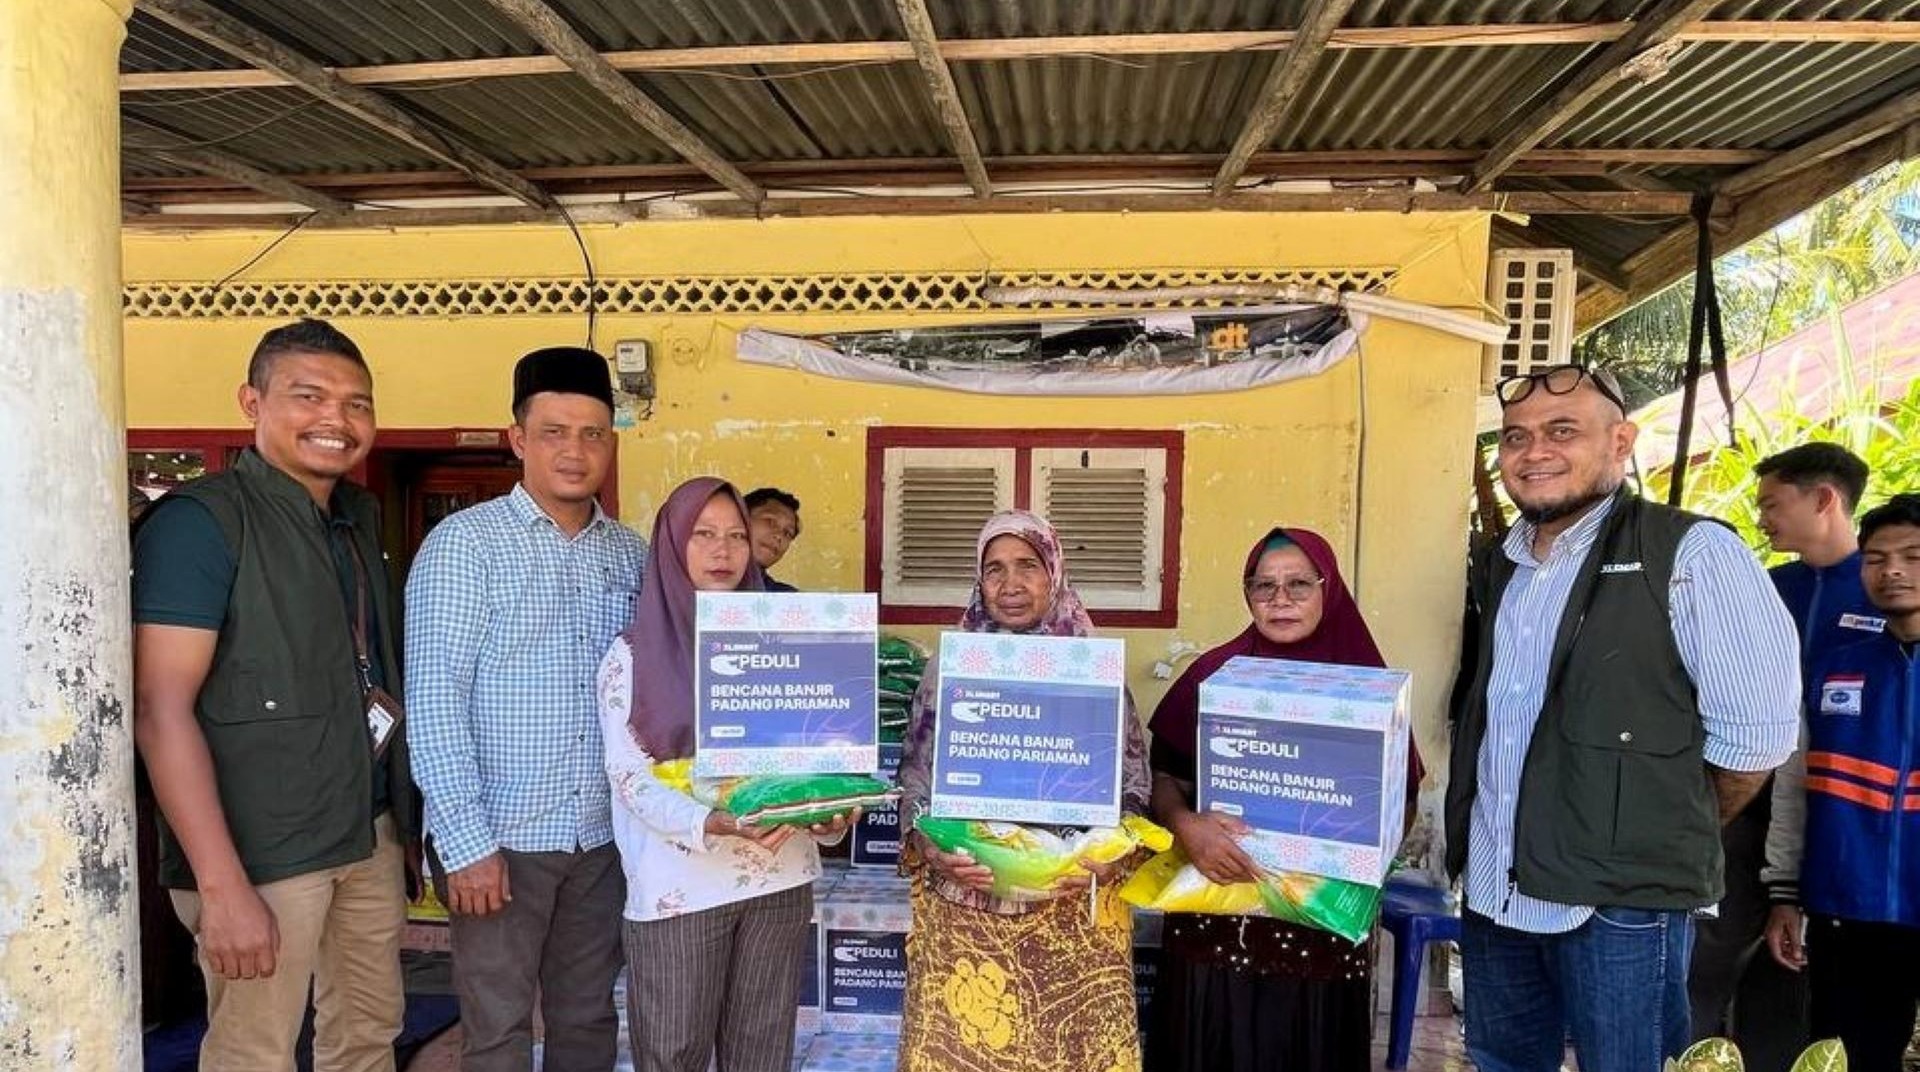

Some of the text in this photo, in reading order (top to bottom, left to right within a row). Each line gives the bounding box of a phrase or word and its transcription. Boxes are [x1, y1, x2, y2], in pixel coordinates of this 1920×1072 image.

[740, 654, 800, 669] PEDULI
[711, 683, 834, 698] BENCANA BANJIR
[711, 697, 850, 712] PADANG PARIAMAN
[980, 702, 1041, 720] PEDULI
[950, 730, 1075, 751] BENCANA BANJIR
[949, 745, 1091, 766] PADANG PARIAMAN
[1237, 739, 1299, 760] PEDULI
[1211, 764, 1336, 791] BENCANA BANJIR
[1211, 776, 1354, 807] PADANG PARIAMAN
[868, 812, 899, 825] PAD
[854, 946, 898, 958] PEDULI
[834, 967, 907, 979] BENCANA BAN
